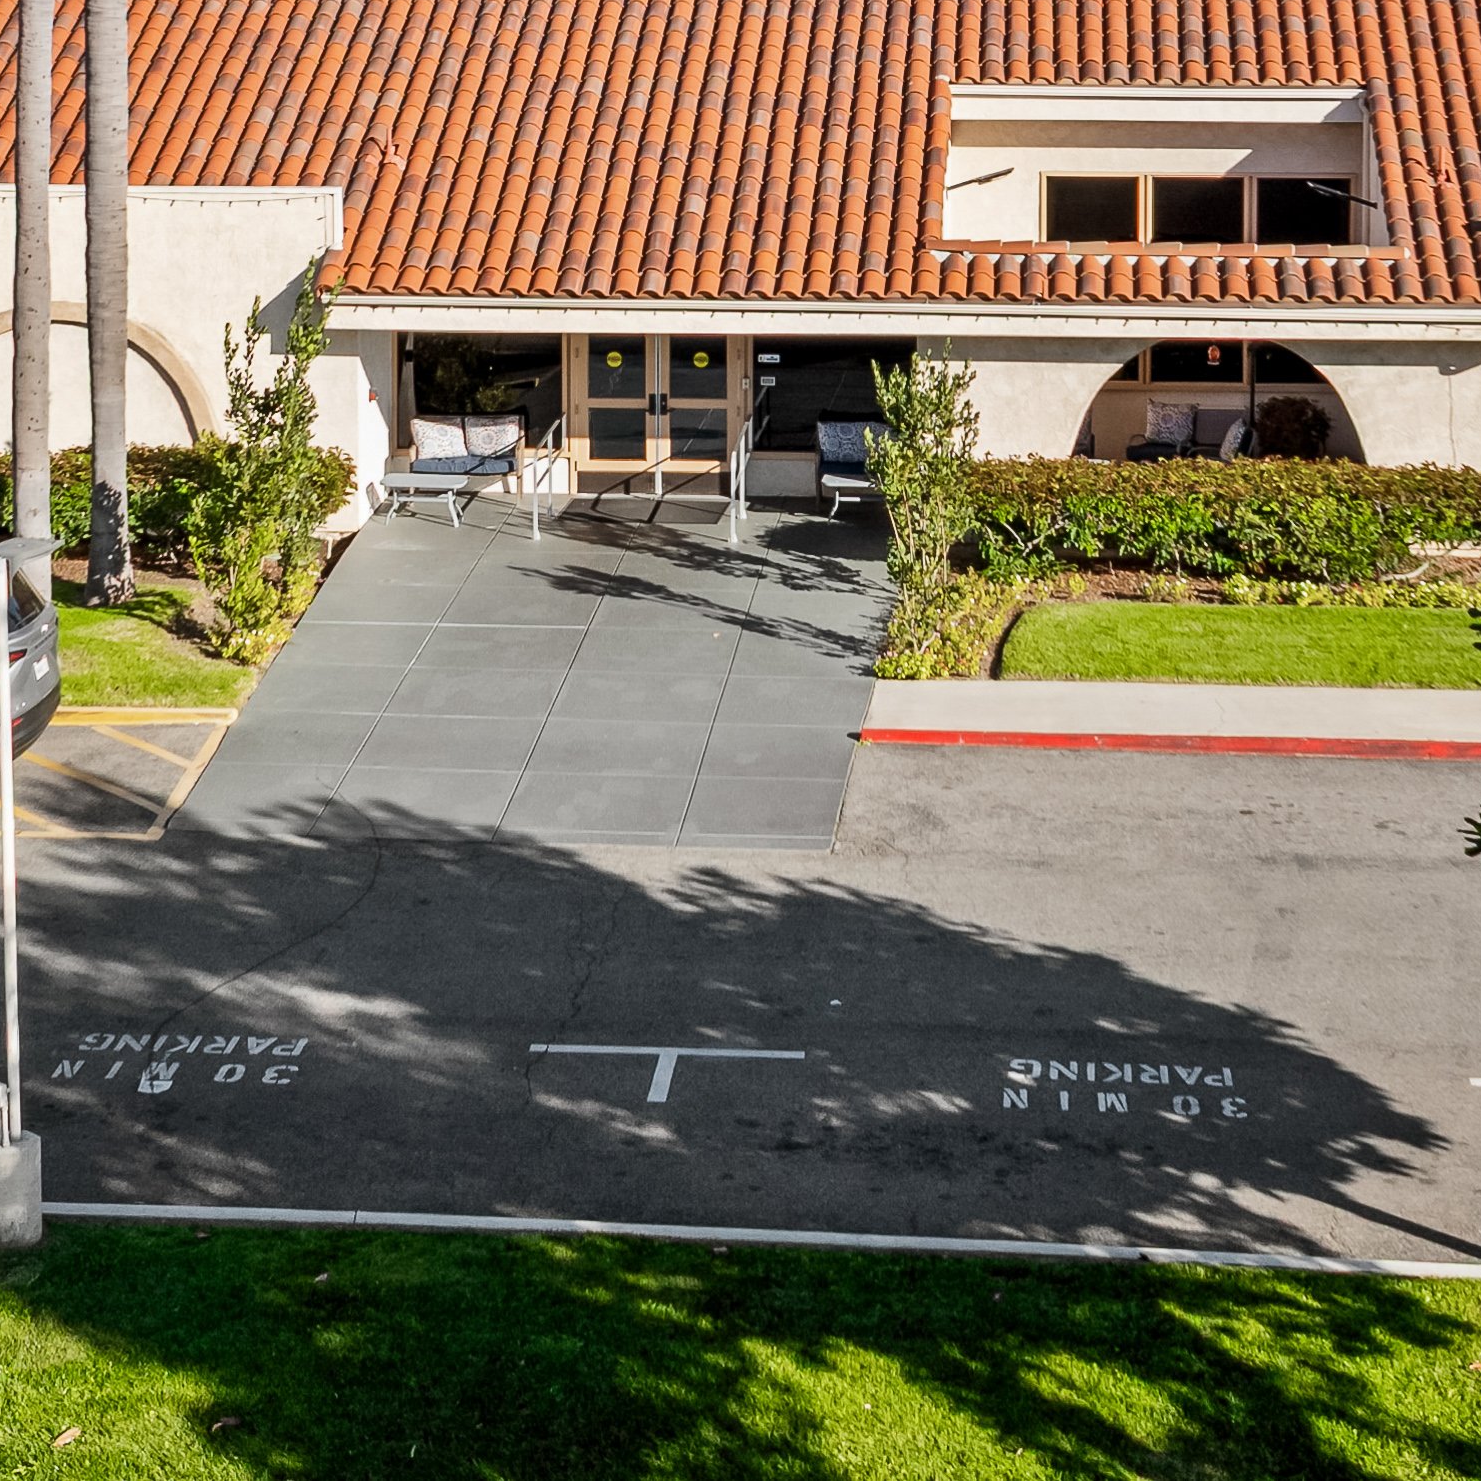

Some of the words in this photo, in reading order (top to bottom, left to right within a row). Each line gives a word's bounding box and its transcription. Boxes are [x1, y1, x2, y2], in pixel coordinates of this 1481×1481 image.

[80, 1032, 309, 1056] PARKING
[51, 1059, 181, 1081] MIN
[214, 1064, 300, 1085] 30
[1009, 1059, 1233, 1087] PARKING
[1003, 1088, 1128, 1113] MIN
[1173, 1095, 1249, 1119] 30
